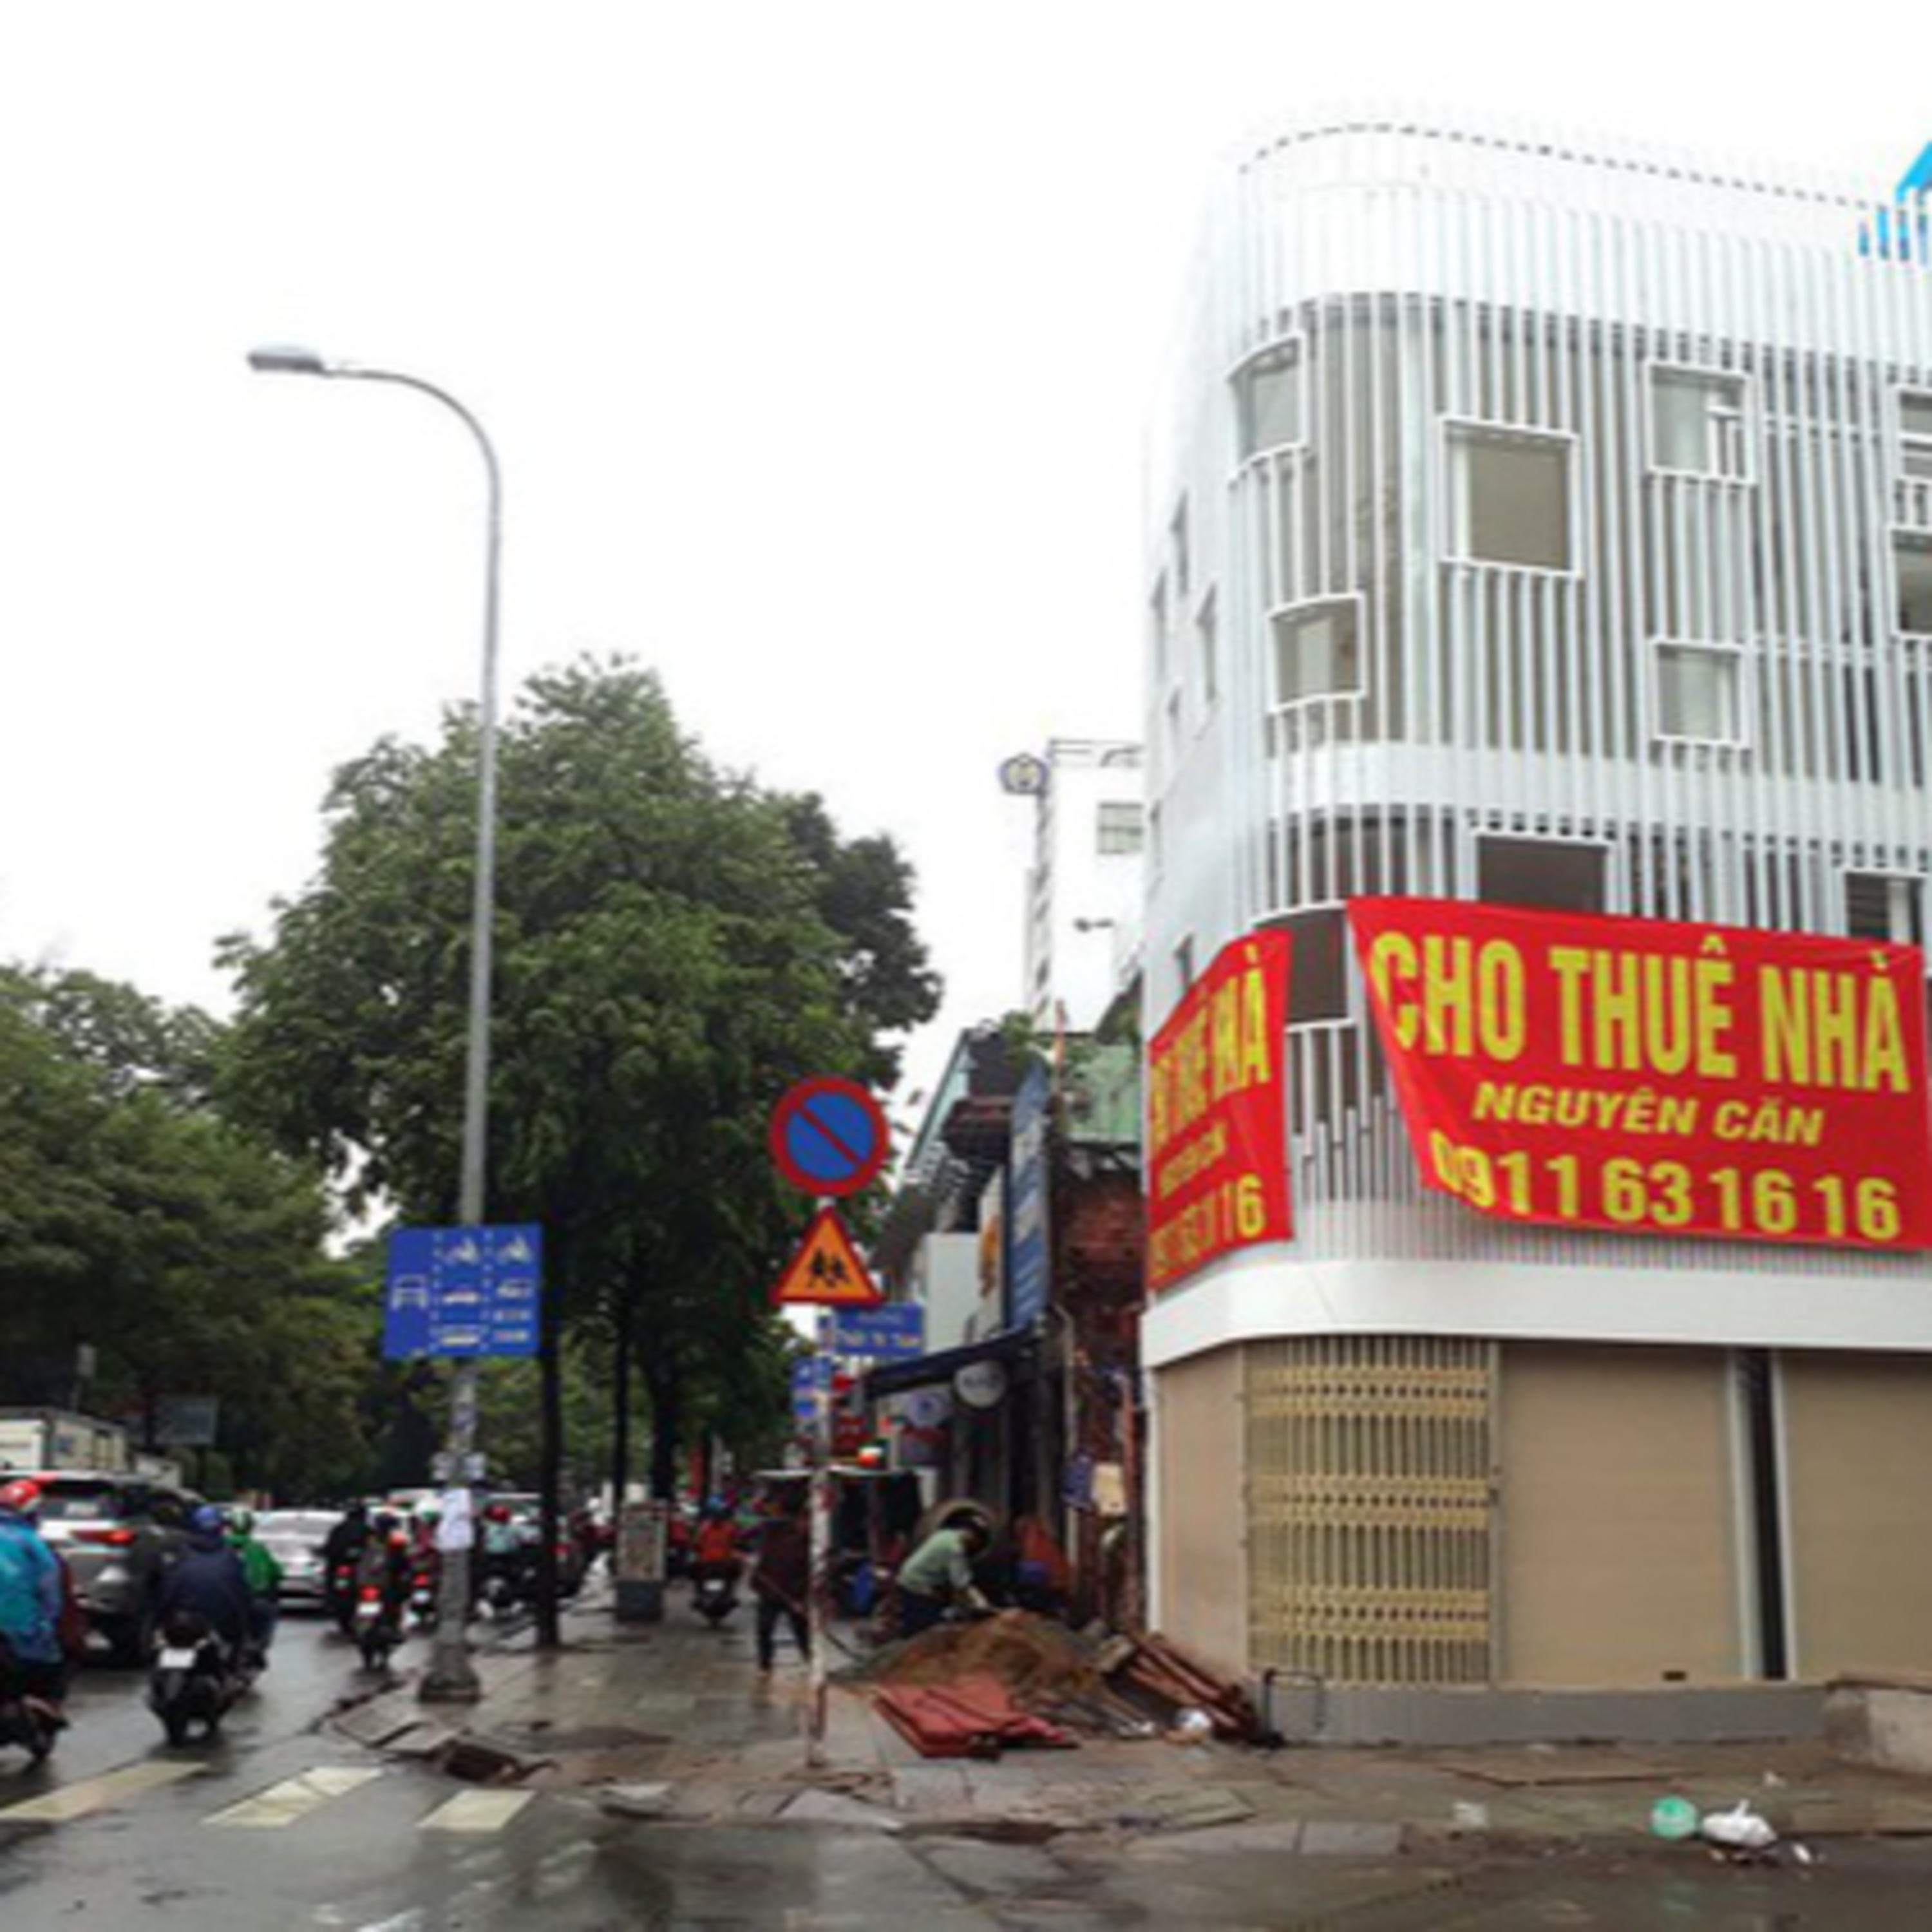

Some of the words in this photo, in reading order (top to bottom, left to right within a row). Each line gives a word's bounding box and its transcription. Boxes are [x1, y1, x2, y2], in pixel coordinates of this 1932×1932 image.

[1370, 931, 1526, 1062] CHO
[1550, 933, 1738, 1079] THUÊ
[1758, 951, 1911, 1094] NHÀ
[1472, 1081, 1698, 1136] NGUYÊN
[1713, 1095, 1824, 1146] CĂN
